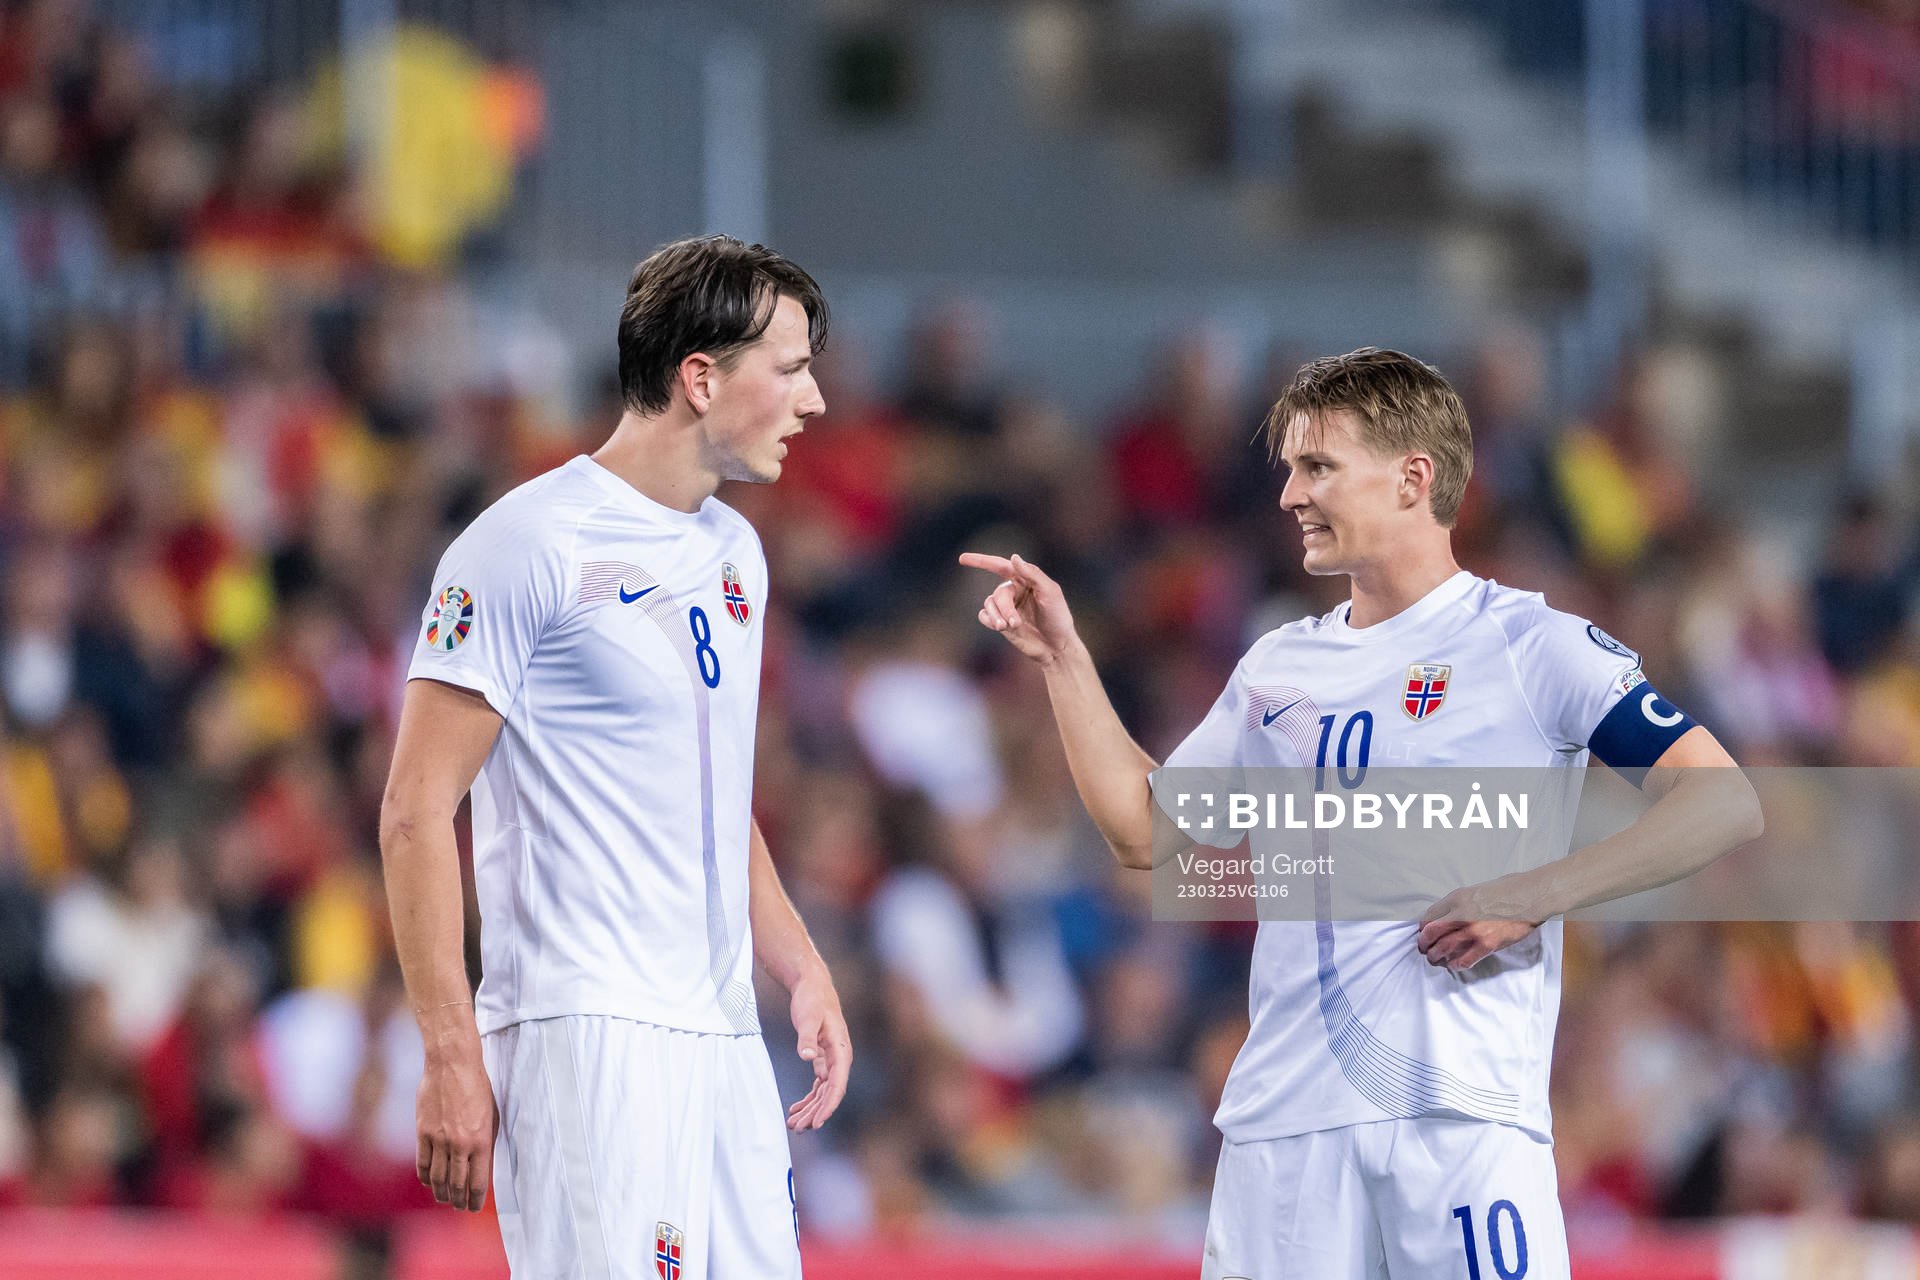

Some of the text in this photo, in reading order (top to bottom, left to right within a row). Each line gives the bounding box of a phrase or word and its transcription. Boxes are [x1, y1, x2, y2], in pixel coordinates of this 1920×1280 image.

[689, 606, 720, 689] 8
[1641, 692, 1684, 727] C
[1314, 710, 1374, 792] 10
[1453, 1199, 1528, 1280] 10
